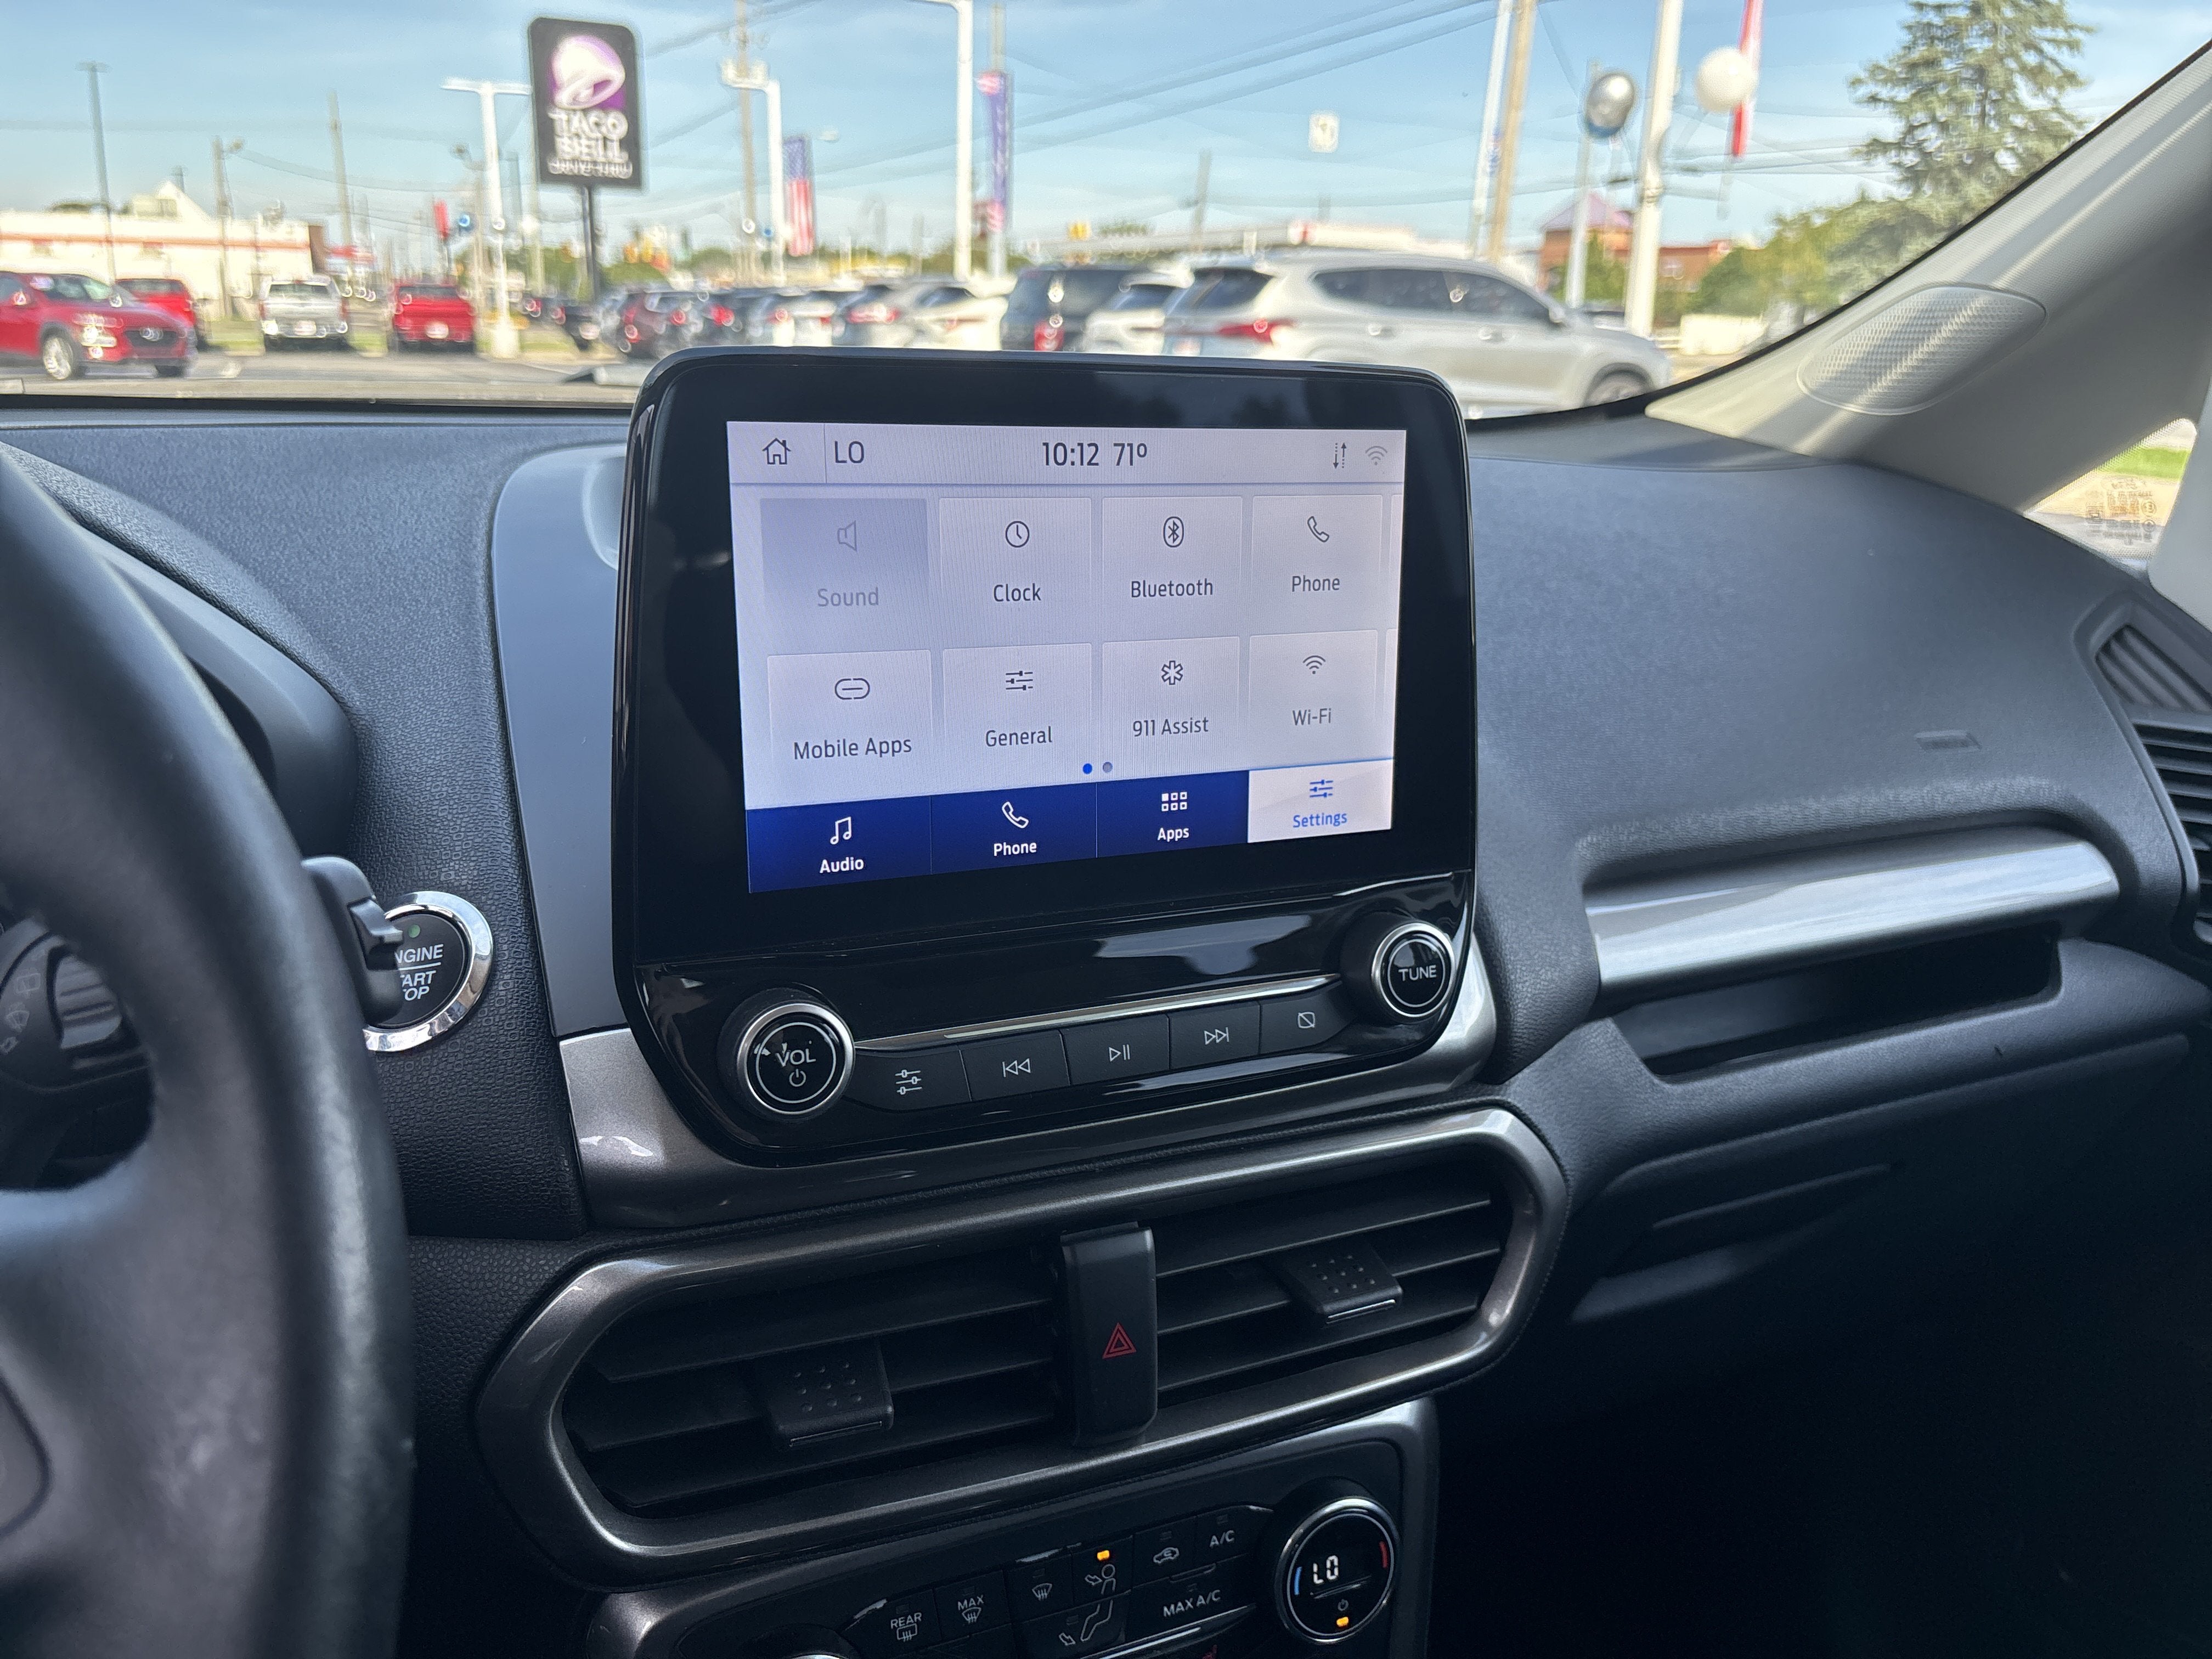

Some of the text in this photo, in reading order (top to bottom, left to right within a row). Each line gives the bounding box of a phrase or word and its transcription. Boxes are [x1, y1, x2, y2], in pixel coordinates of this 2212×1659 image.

[549, 109, 628, 139] TACO
[555, 136, 629, 163] BELL
[834, 441, 864, 464] LO
[1043, 442, 1099, 466] 10:12
[993, 583, 1041, 602] Clock
[1131, 578, 1214, 597] Bluetooth
[1292, 575, 1340, 592] Phone
[817, 587, 878, 606] Sound
[1133, 716, 1209, 737] 911 Assist
[1293, 708, 1332, 726] Wi-Fi
[986, 726, 1052, 747] General
[794, 737, 912, 760] Mobile Apps
[1293, 811, 1347, 828] Settings
[1158, 826, 1189, 842] Apps
[994, 841, 1037, 856] Phone
[820, 857, 865, 873] Audio
[394, 944, 444, 963] NGINE
[400, 970, 437, 987] ART
[1398, 964, 1437, 981] TUNE
[402, 986, 430, 1001] OP
[775, 1048, 816, 1067] VOL
[1209, 1530, 1235, 1548] A/C
[1312, 1555, 1339, 1584] LO
[957, 1595, 985, 1611] MAX
[1163, 1589, 1221, 1617] MAX A/C
[890, 1612, 922, 1629] REAR
